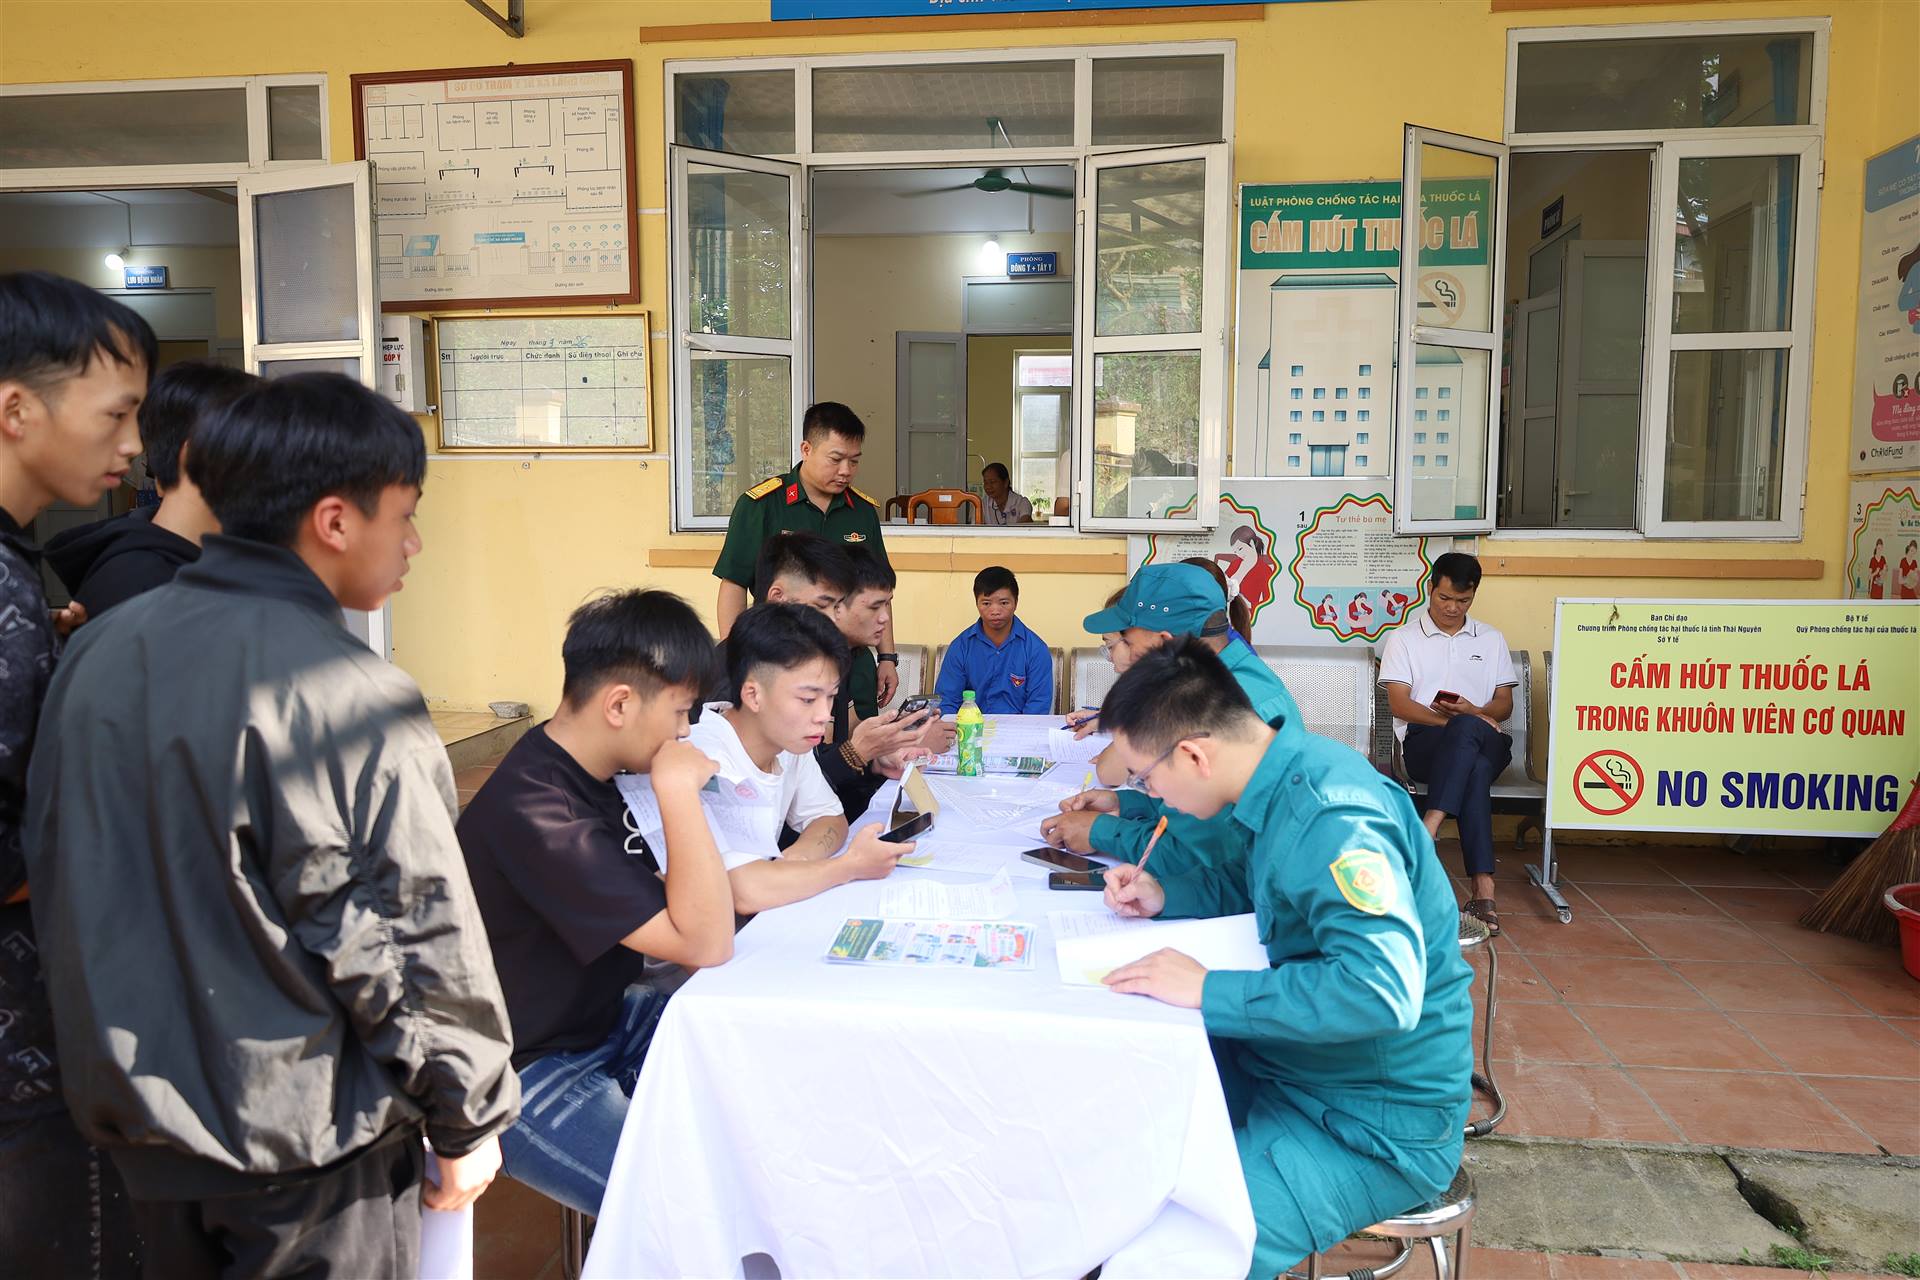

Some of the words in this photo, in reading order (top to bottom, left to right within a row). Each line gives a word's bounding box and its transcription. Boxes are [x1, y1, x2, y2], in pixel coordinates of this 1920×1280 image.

[1250, 196, 1274, 208] LUẬT
[1276, 196, 1314, 206] PHÒNG
[1317, 194, 1356, 205] CHỐNG
[1360, 194, 1380, 204] TÁC
[1430, 190, 1466, 202] THUỐC
[1469, 190, 1480, 200] LÁ
[1250, 210, 1303, 254] CẤM
[1309, 214, 1358, 252] HÚT
[1450, 210, 1479, 249] LÁ
[1871, 446, 1903, 458] ChildFund
[1857, 504, 1862, 515] 3
[1300, 511, 1305, 521] 1
[1676, 614, 1688, 622] đạo
[1862, 614, 1869, 622] tế
[1671, 626, 1680, 634] hại
[1682, 624, 1700, 632] thuốc
[1832, 625, 1851, 633] chống
[1865, 626, 1875, 634] hại
[1890, 625, 1908, 633] thuốc
[1610, 653, 1671, 689] CẤM
[1679, 658, 1731, 689] HÚT
[1740, 654, 1828, 691] THUỐC
[1838, 659, 1871, 691] LÁ
[1576, 706, 1649, 732] TRONG
[1656, 702, 1735, 733] KHUÔN
[1742, 702, 1795, 734] VIÊN
[1803, 706, 1835, 735] CƠ
[1841, 709, 1905, 738] QUAN
[1656, 770, 1708, 806] NO
[1720, 771, 1899, 812] SMOKING
